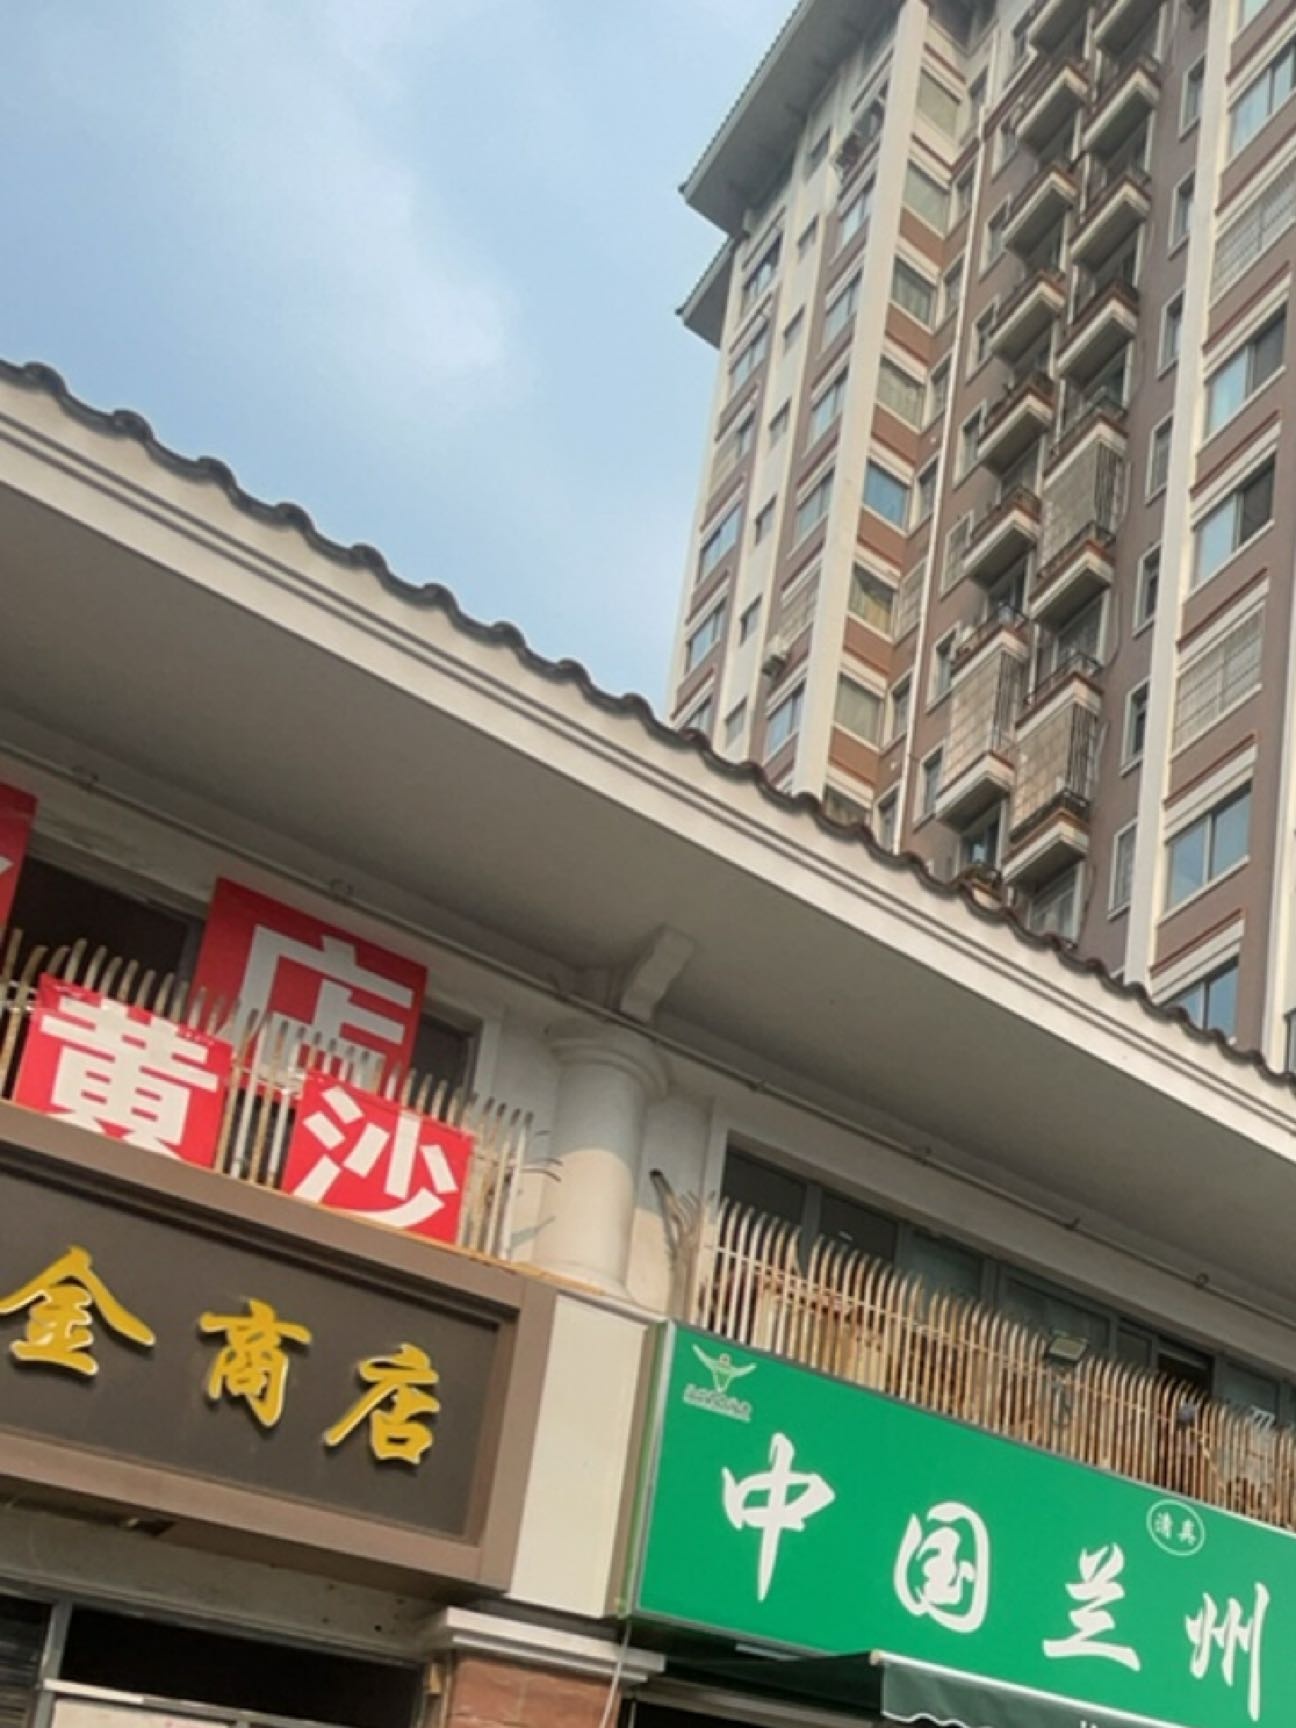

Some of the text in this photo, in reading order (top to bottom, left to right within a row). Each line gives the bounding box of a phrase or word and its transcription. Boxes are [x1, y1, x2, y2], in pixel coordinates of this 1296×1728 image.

[217, 922, 413, 1092] 店
[41, 990, 459, 1228] 黄沙
[0, 1244, 441, 1465] 金商店
[1154, 1511, 1197, 1546] 清真
